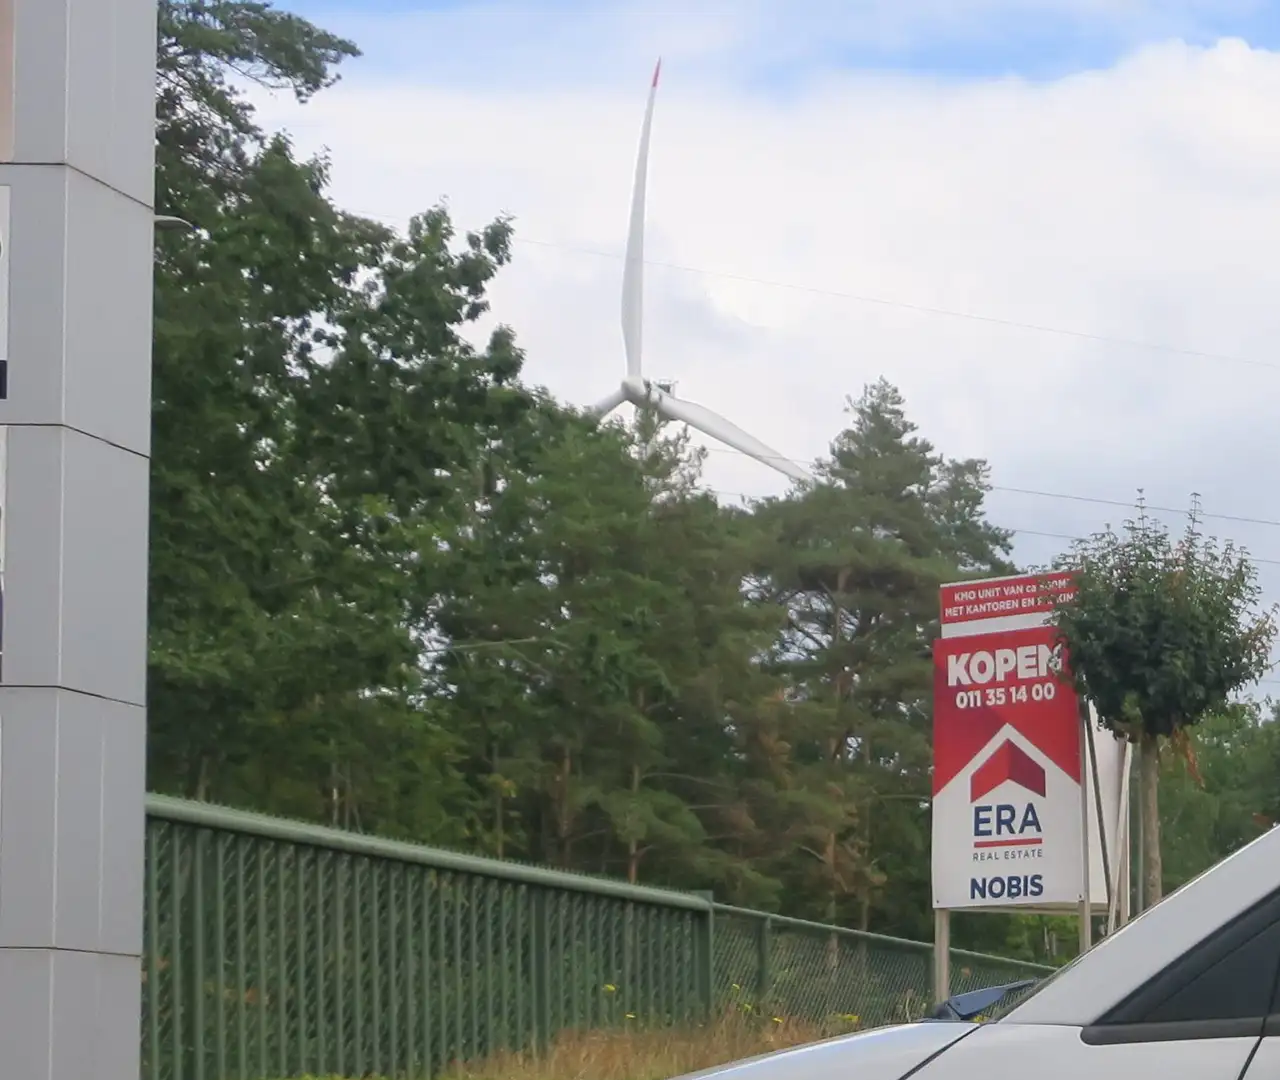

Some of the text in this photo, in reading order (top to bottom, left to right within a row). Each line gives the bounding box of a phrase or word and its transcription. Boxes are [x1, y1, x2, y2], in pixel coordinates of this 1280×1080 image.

[954, 590, 976, 602] KMO
[978, 588, 1001, 598] UNIT
[1003, 585, 1024, 597] VAN
[1025, 585, 1037, 593] ca
[945, 606, 963, 617] MET
[966, 599, 1019, 614] KANTOREN
[1021, 598, 1035, 608] EN
[947, 643, 1062, 686] KOPEN
[956, 682, 1055, 709] 011 35 14 00
[974, 802, 1042, 836] ERA
[972, 849, 1043, 861] REAL ESTATE
[970, 874, 1044, 899] NOBIS
